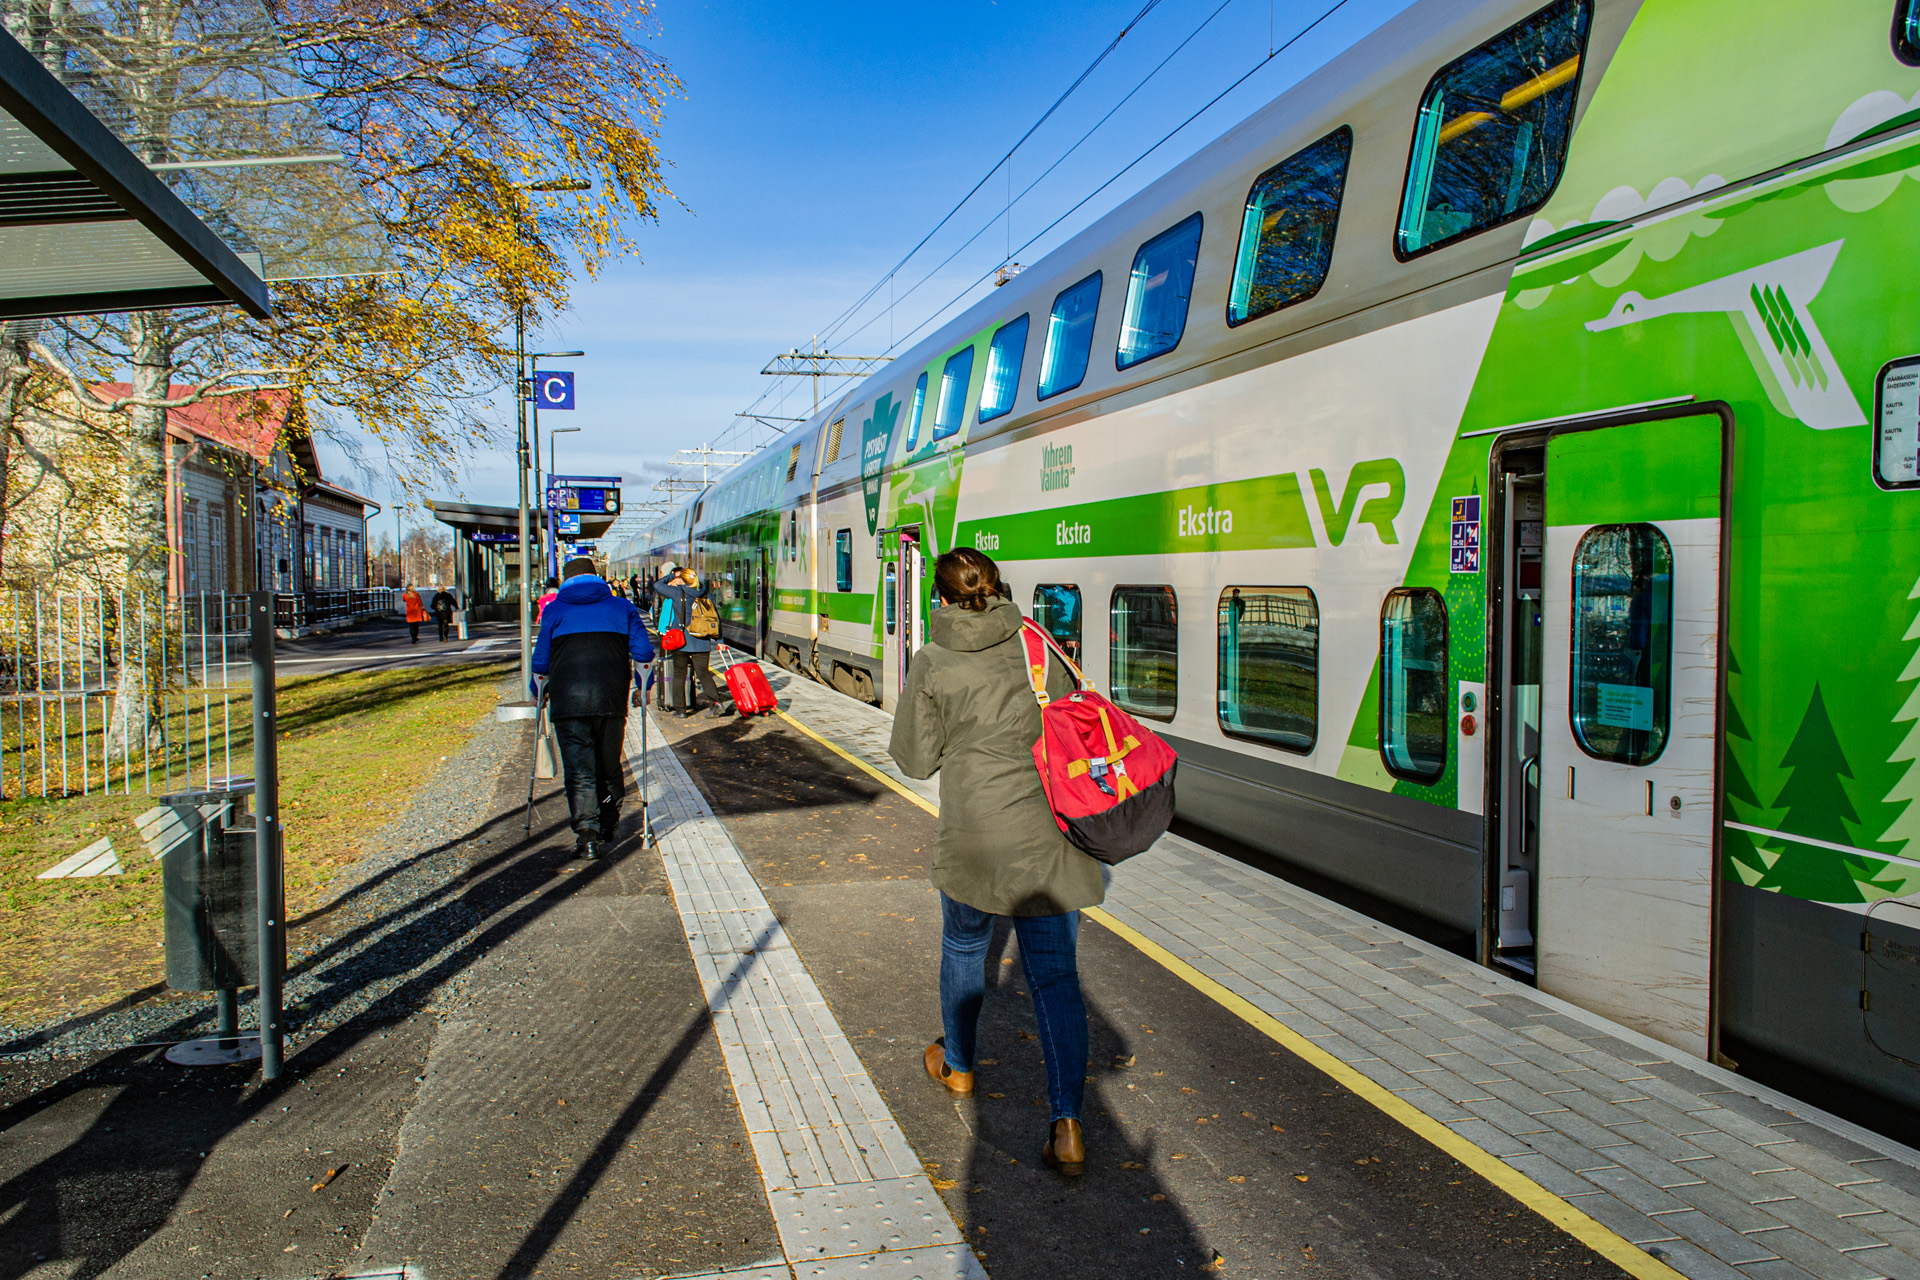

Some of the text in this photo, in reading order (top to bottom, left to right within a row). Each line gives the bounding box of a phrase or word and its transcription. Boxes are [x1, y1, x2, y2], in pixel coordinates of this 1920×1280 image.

[544, 377, 566, 404] C
[1042, 441, 1073, 469] Vihrein
[1040, 466, 1070, 493] Valinta
[1308, 457, 1406, 547] VR
[1056, 520, 1091, 546] Ekstra
[1178, 504, 1233, 537] Ekstra
[975, 530, 999, 552] Ekstra
